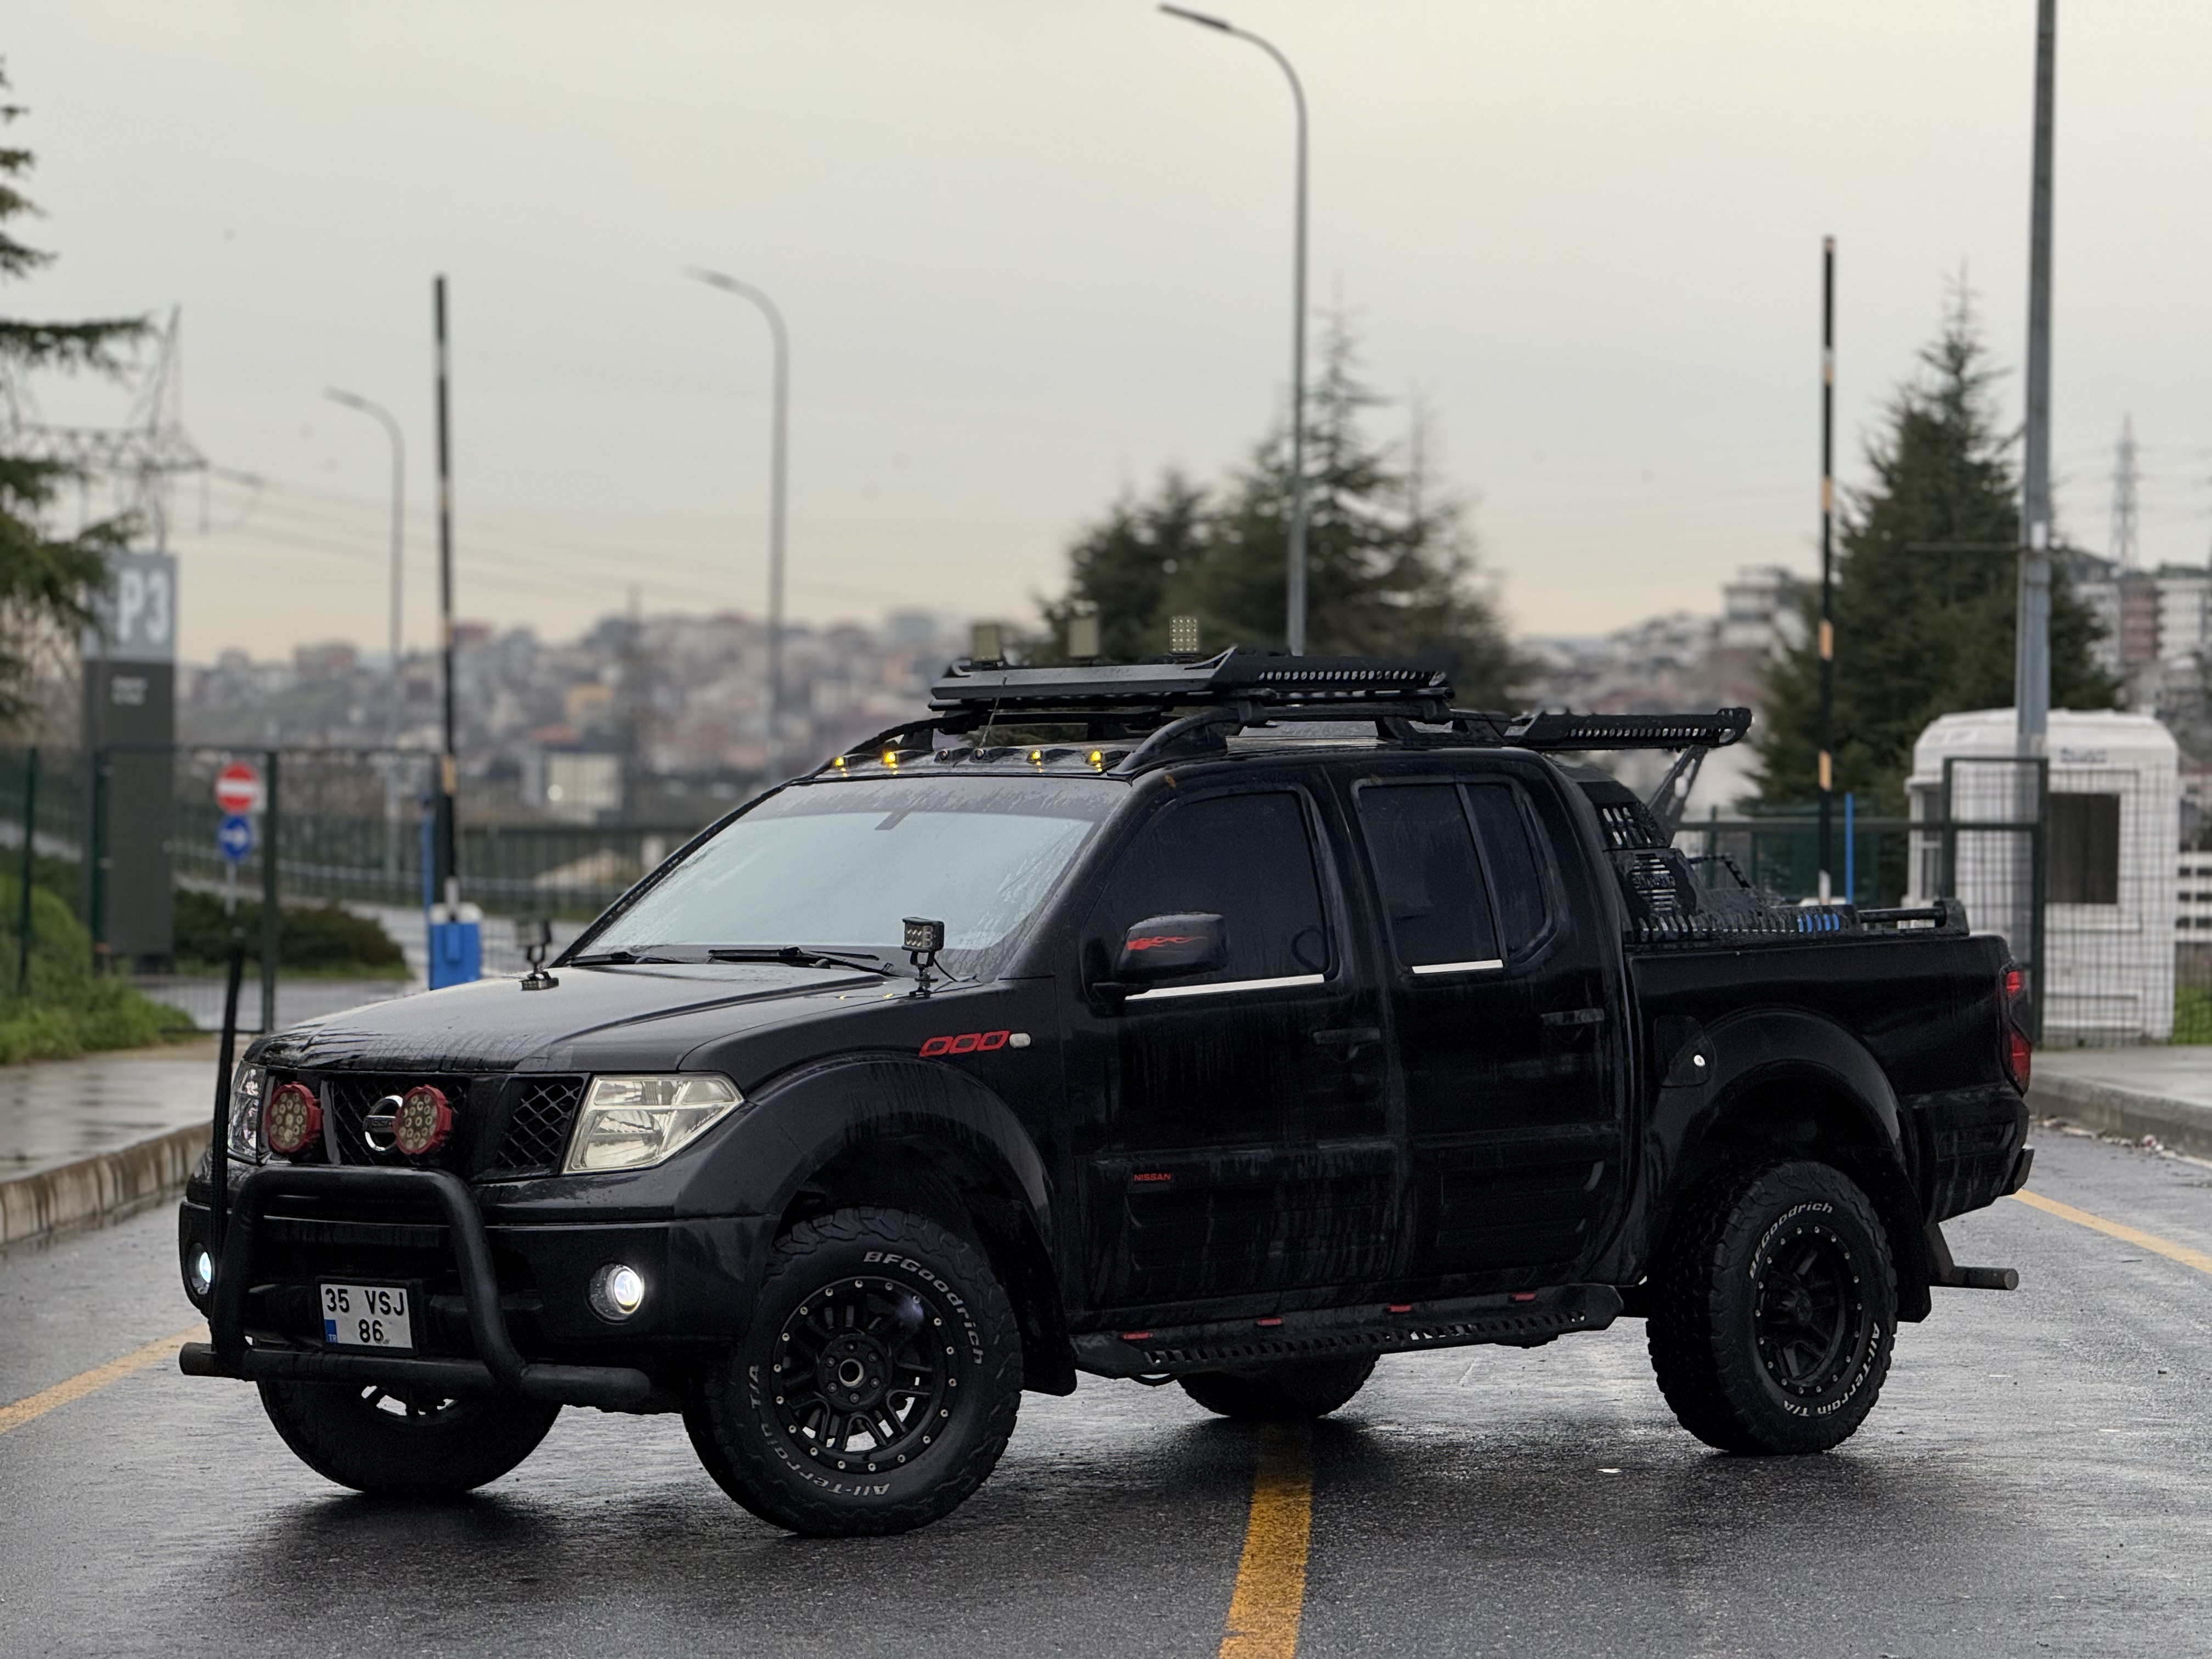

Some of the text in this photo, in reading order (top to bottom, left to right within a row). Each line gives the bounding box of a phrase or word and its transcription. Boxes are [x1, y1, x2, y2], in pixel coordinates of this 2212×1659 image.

[1750, 1201, 1833, 1279] BFGoodrich
[325, 1288, 404, 1316] 35 VSJ
[329, 1334, 337, 1342] TR
[359, 1319, 384, 1342] 86
[863, 1251, 983, 1364] BFGoodrich
[1784, 1322, 1880, 1417] All-Terrain T/A
[748, 1365, 890, 1496] All-Terrain T/A
